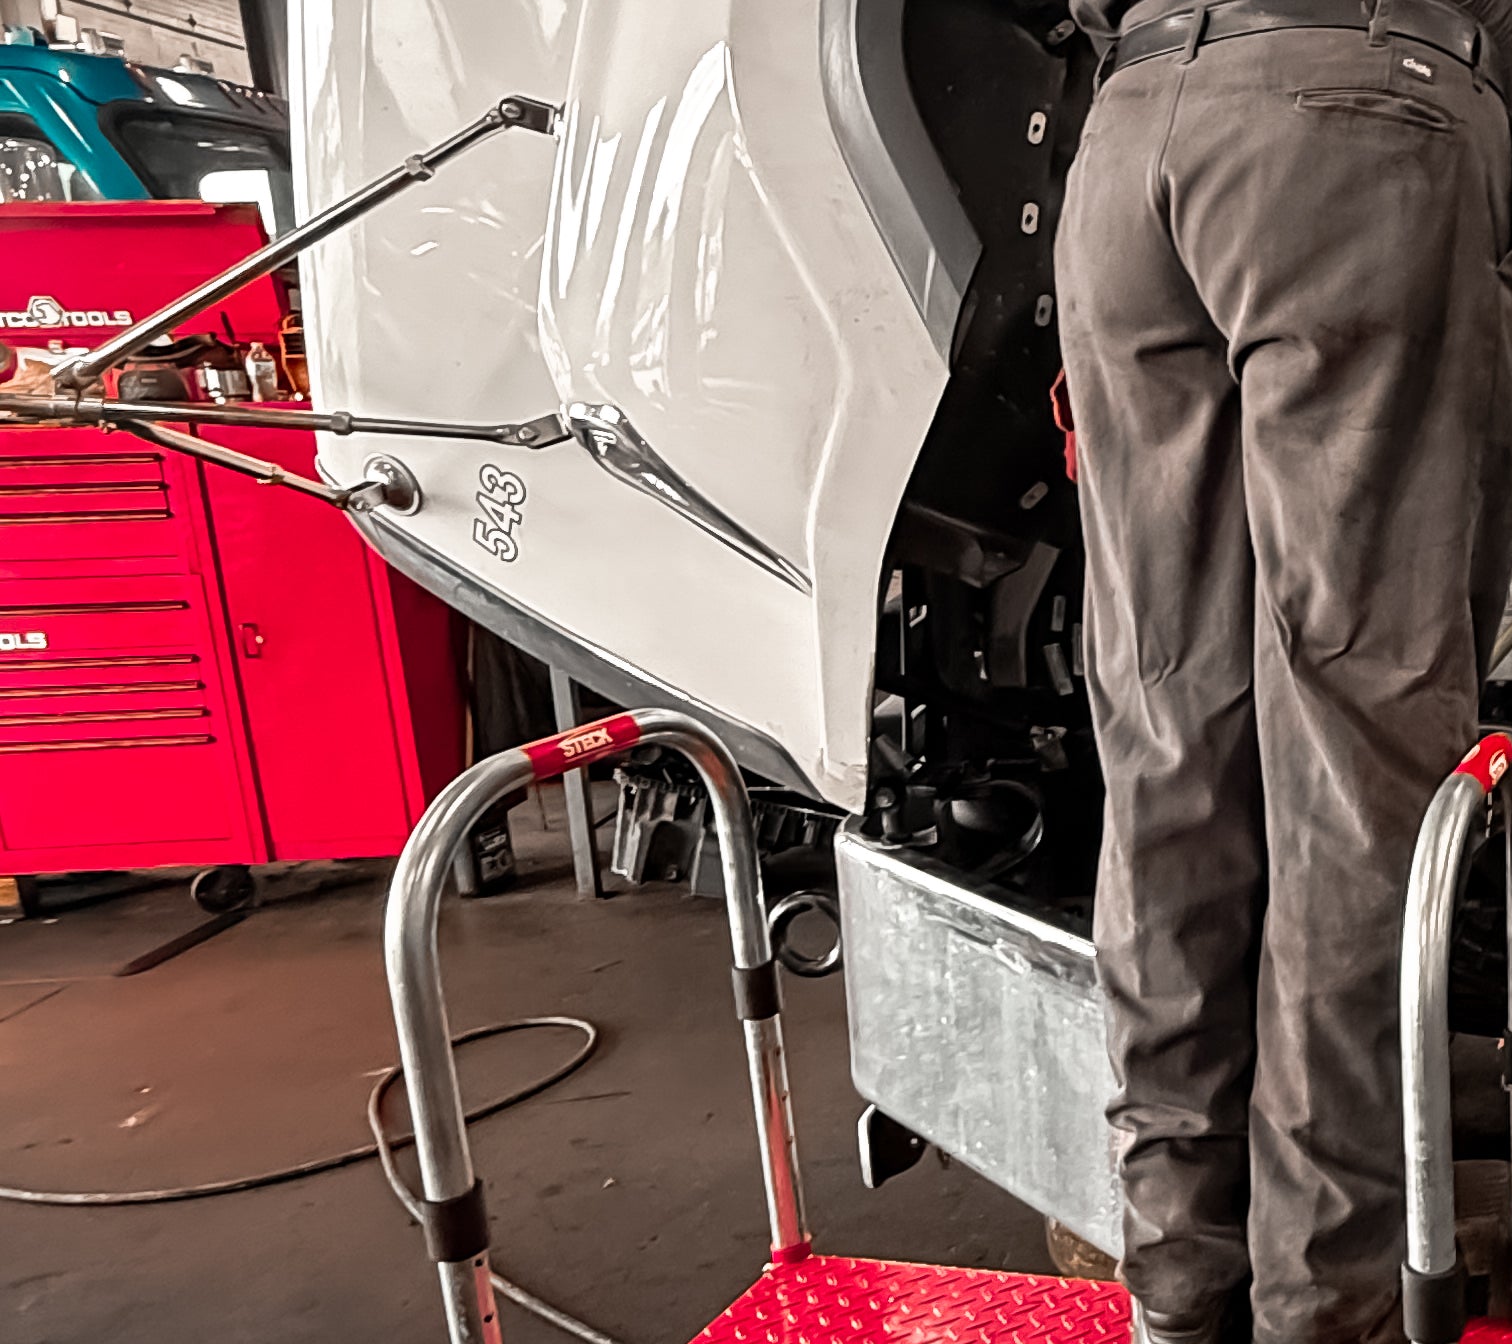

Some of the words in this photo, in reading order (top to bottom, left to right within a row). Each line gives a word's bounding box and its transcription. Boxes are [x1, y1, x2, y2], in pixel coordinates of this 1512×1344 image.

[62, 310, 133, 327] TOOLS
[472, 463, 527, 562] 543
[0, 632, 47, 650] OLS
